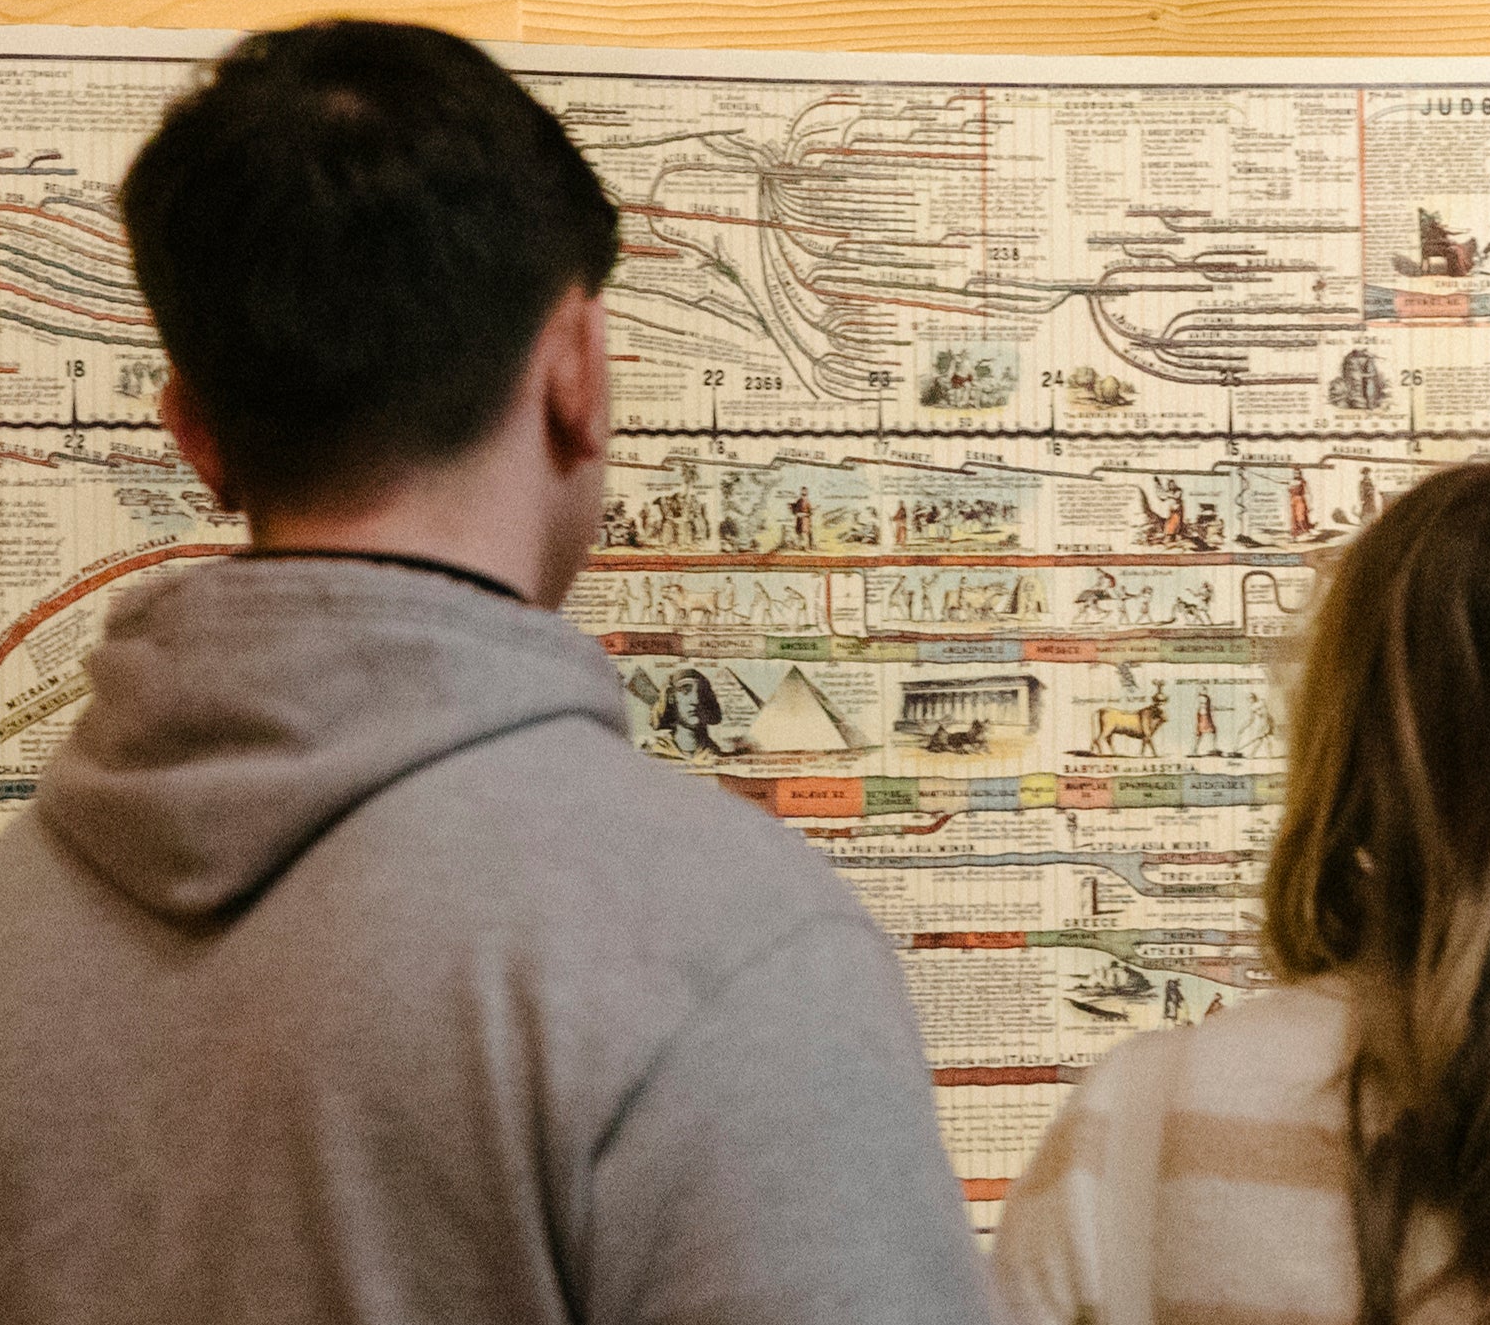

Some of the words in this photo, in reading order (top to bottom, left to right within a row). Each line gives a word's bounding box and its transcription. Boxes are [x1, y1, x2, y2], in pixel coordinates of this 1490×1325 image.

[66, 360, 84, 377] 18
[703, 370, 724, 387] 22
[745, 376, 783, 391] 2369
[1042, 371, 1064, 388] 24
[1401, 369, 1423, 386] 26
[63, 435, 84, 449] 22
[1063, 918, 1118, 928] GREECE
